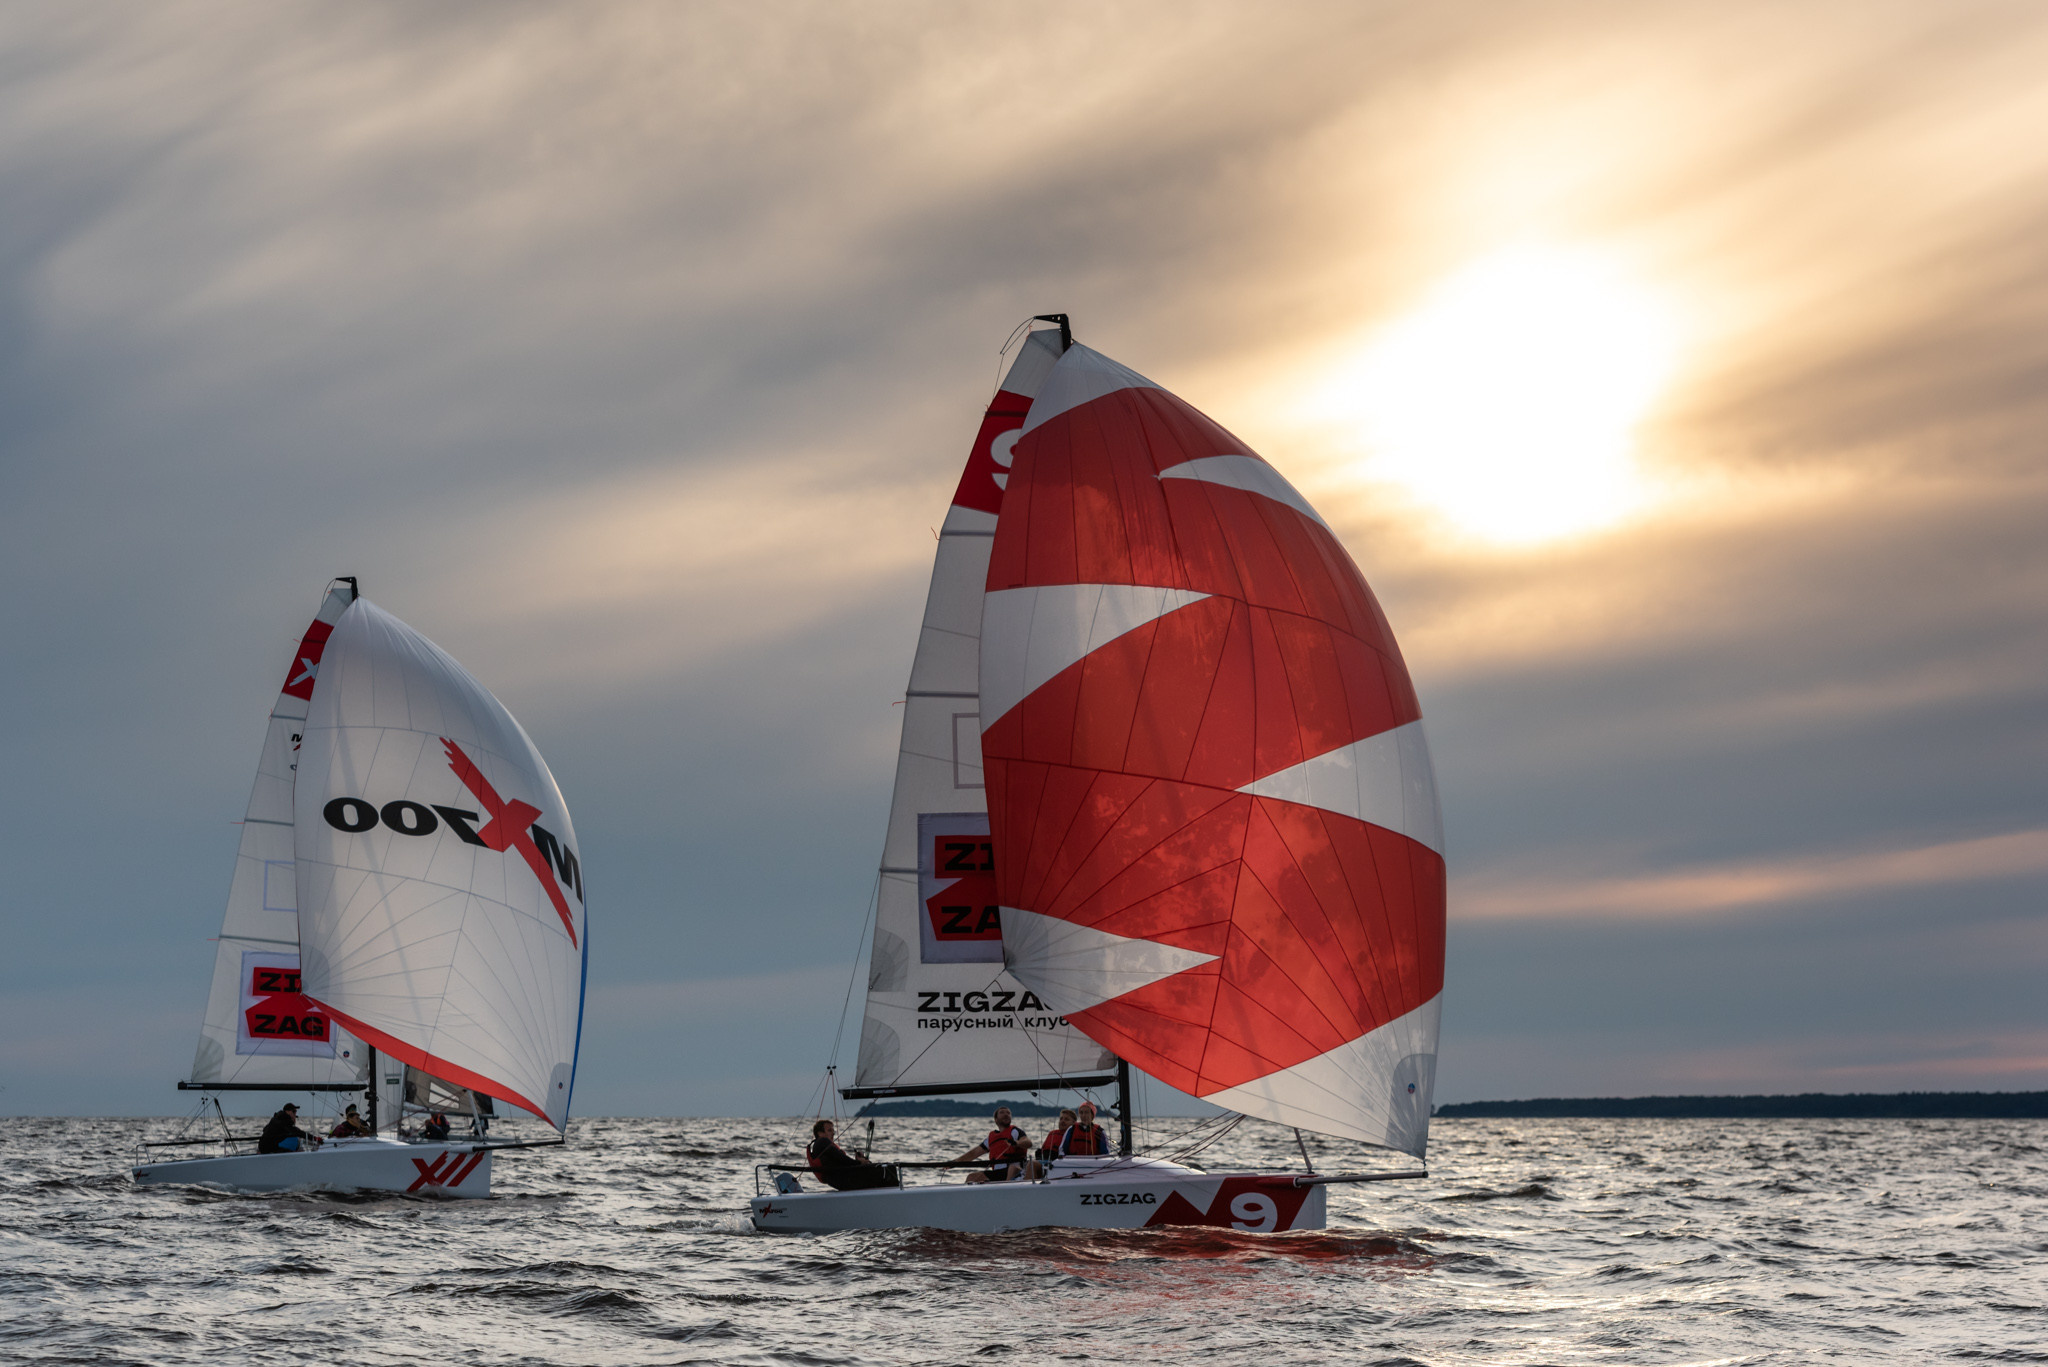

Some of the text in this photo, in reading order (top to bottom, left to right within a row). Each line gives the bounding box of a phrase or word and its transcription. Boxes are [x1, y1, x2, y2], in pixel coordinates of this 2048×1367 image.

[918, 991, 1053, 1013] ZIGZA
[254, 1014, 325, 1037] ZAG
[918, 1015, 1070, 1032] парусный клуб
[1080, 1193, 1157, 1206] ZIGZAG
[1230, 1192, 1279, 1232] 9
